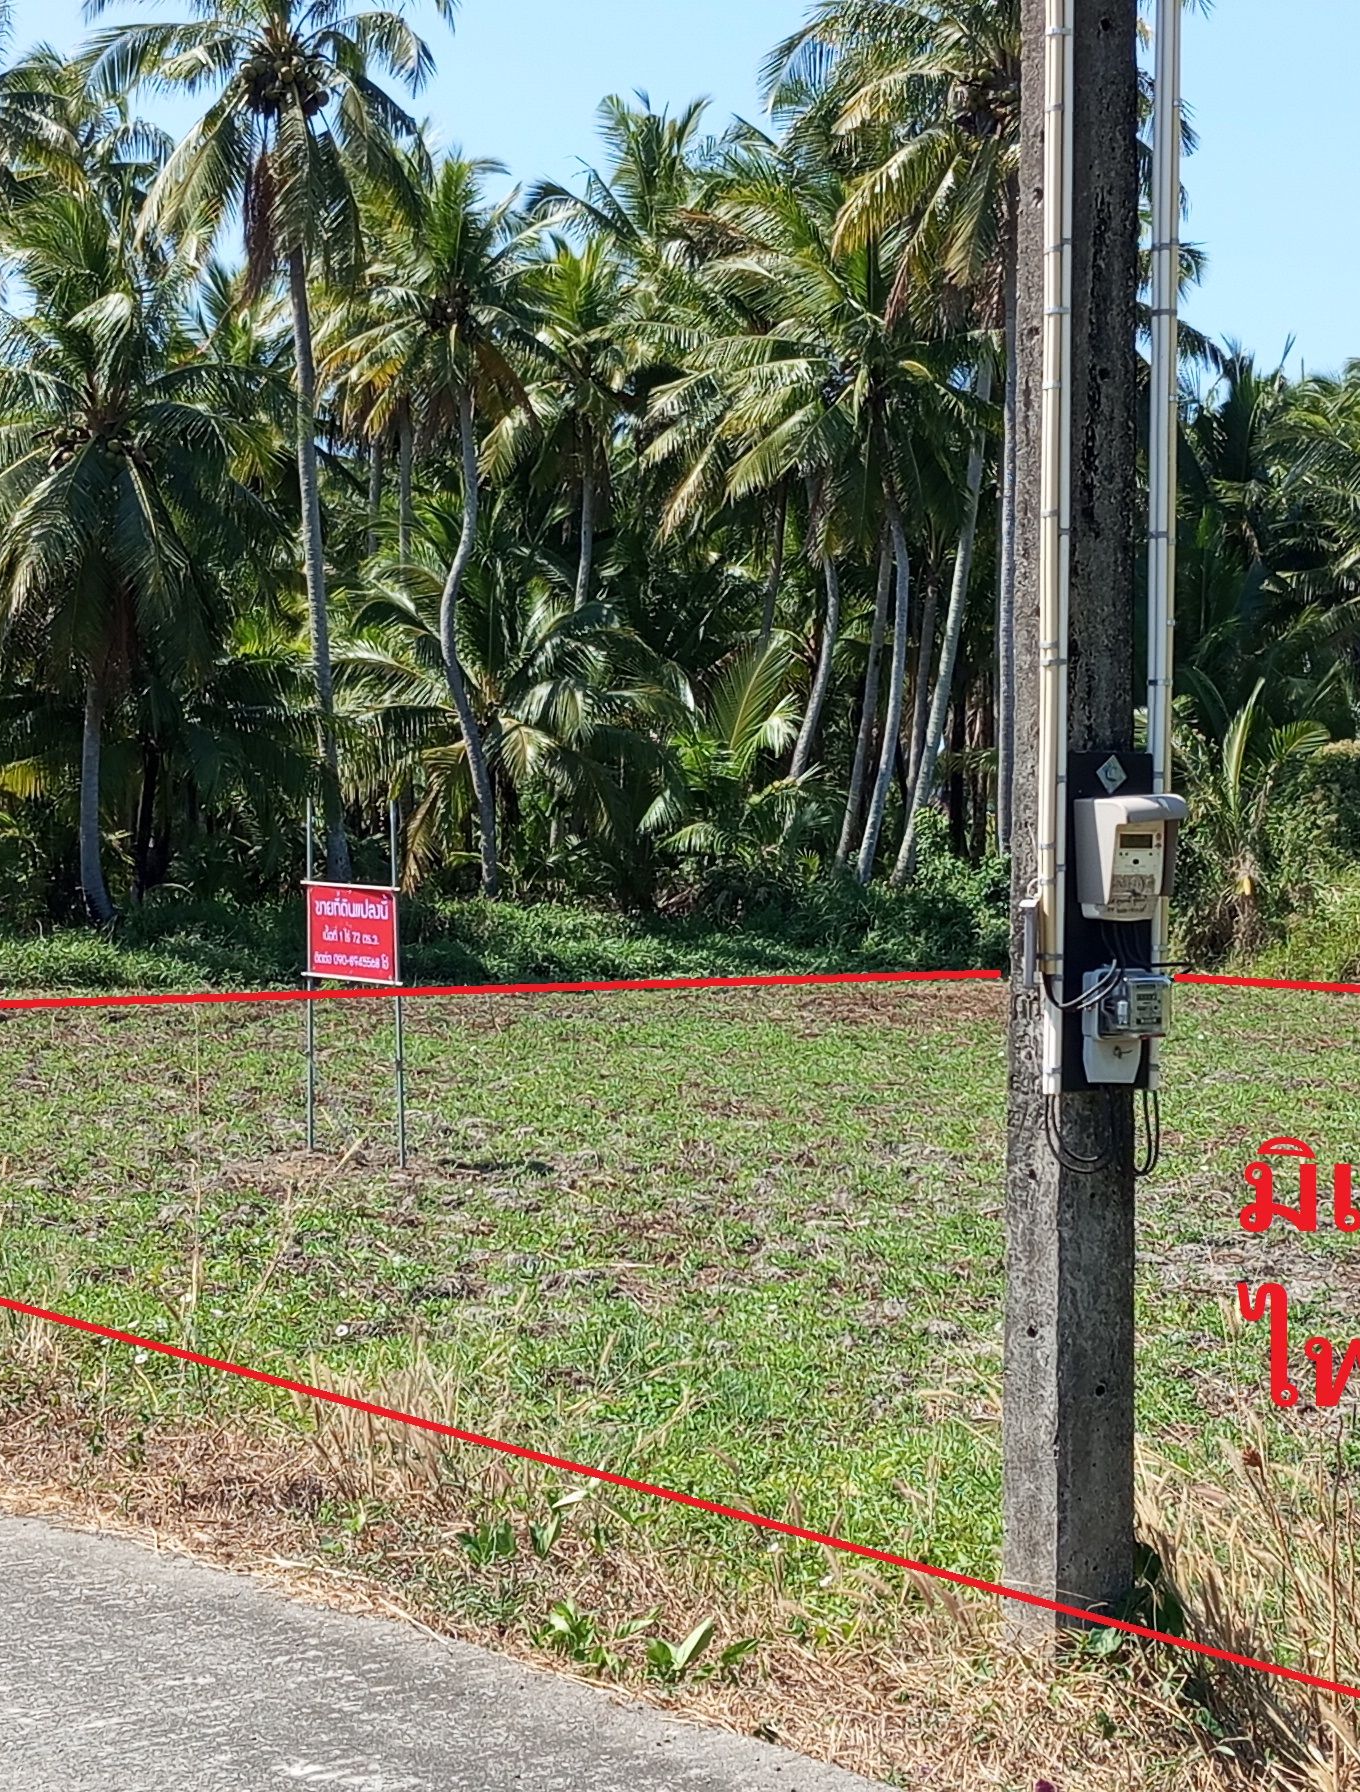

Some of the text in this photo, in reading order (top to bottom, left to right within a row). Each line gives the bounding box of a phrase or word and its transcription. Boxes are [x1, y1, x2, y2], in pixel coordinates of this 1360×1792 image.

[315, 891, 389, 920] ขายที่ดินแปลงนี้
[352, 931, 361, 944] 72
